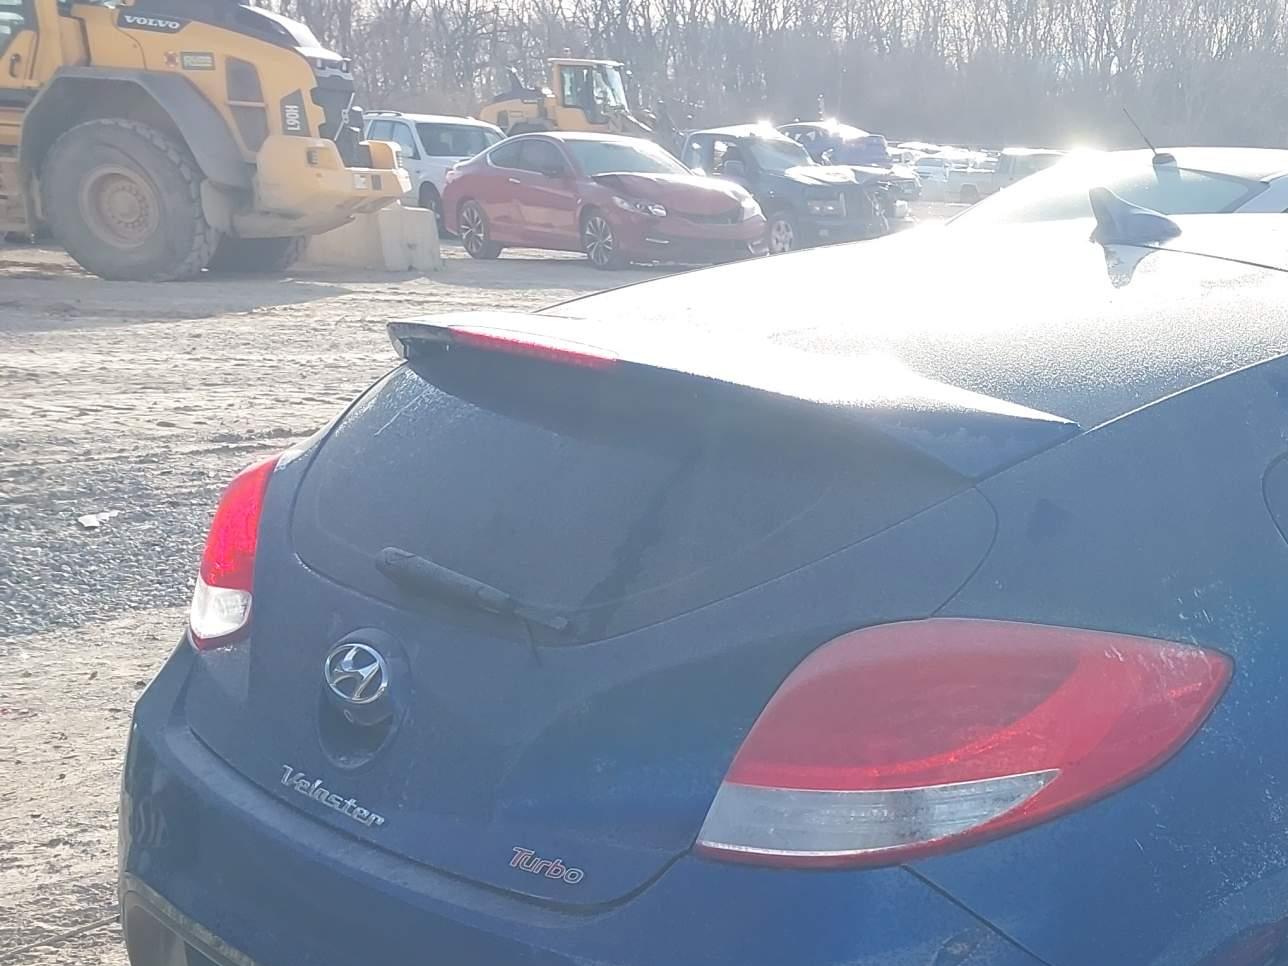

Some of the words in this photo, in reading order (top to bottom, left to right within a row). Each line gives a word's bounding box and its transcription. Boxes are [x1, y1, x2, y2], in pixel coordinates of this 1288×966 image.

[124, 15, 180, 29] VOLVO
[284, 104, 301, 131] L90H
[280, 764, 385, 827] Veloster
[509, 846, 584, 884] Turbo
